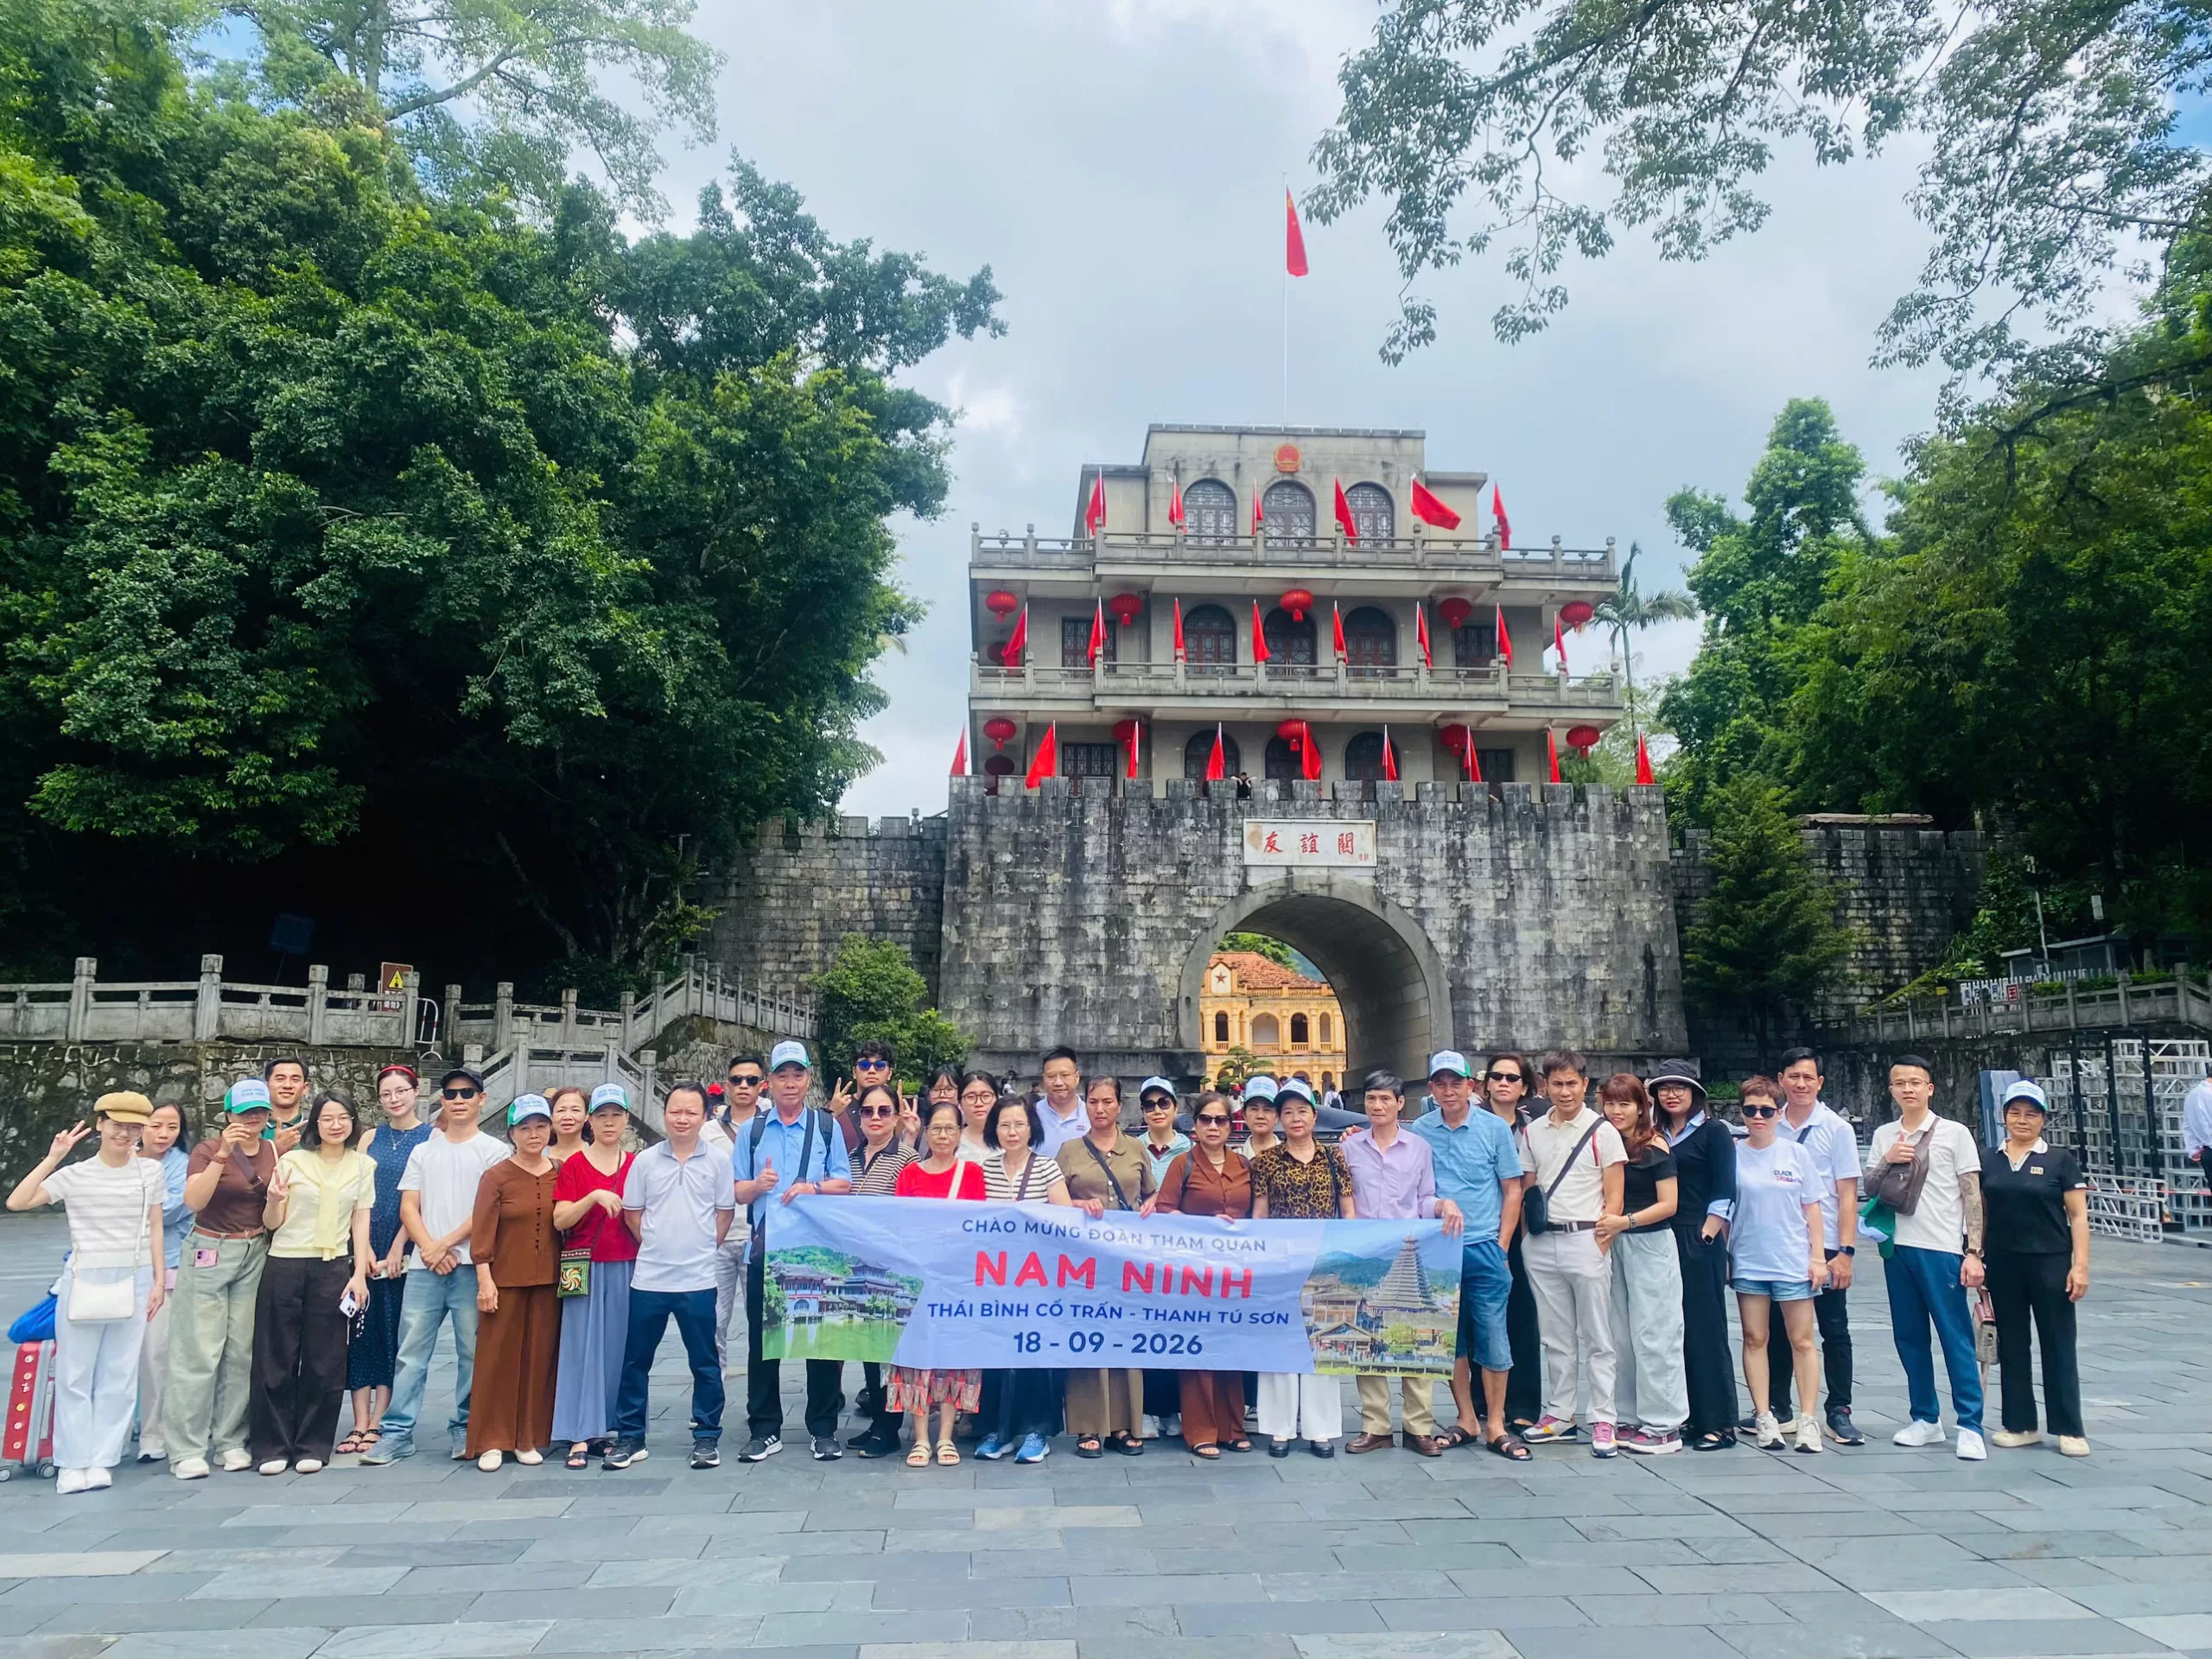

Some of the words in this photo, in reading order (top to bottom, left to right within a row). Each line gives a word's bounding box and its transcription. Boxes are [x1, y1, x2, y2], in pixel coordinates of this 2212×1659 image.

[962, 1217, 1017, 1233] CHÀO
[1024, 1219, 1080, 1238] MỪNG
[1088, 1227, 1142, 1244] ĐOÀN
[1149, 1234, 1205, 1249] THAM
[1211, 1238, 1266, 1252] QUAN
[975, 1251, 1096, 1290] NAM
[1122, 1261, 1253, 1299] NINH
[927, 1300, 974, 1318] THÁI
[980, 1299, 1029, 1318] BÌNH
[1035, 1298, 1064, 1318] CỔ
[1070, 1301, 1123, 1319] TRẤN
[1141, 1307, 1211, 1323] THANH
[1217, 1308, 1243, 1324] TÚ
[1249, 1310, 1290, 1325] SƠN
[1014, 1332, 1041, 1353] 18
[1068, 1332, 1105, 1353] 09
[1130, 1332, 1204, 1355] 2026
